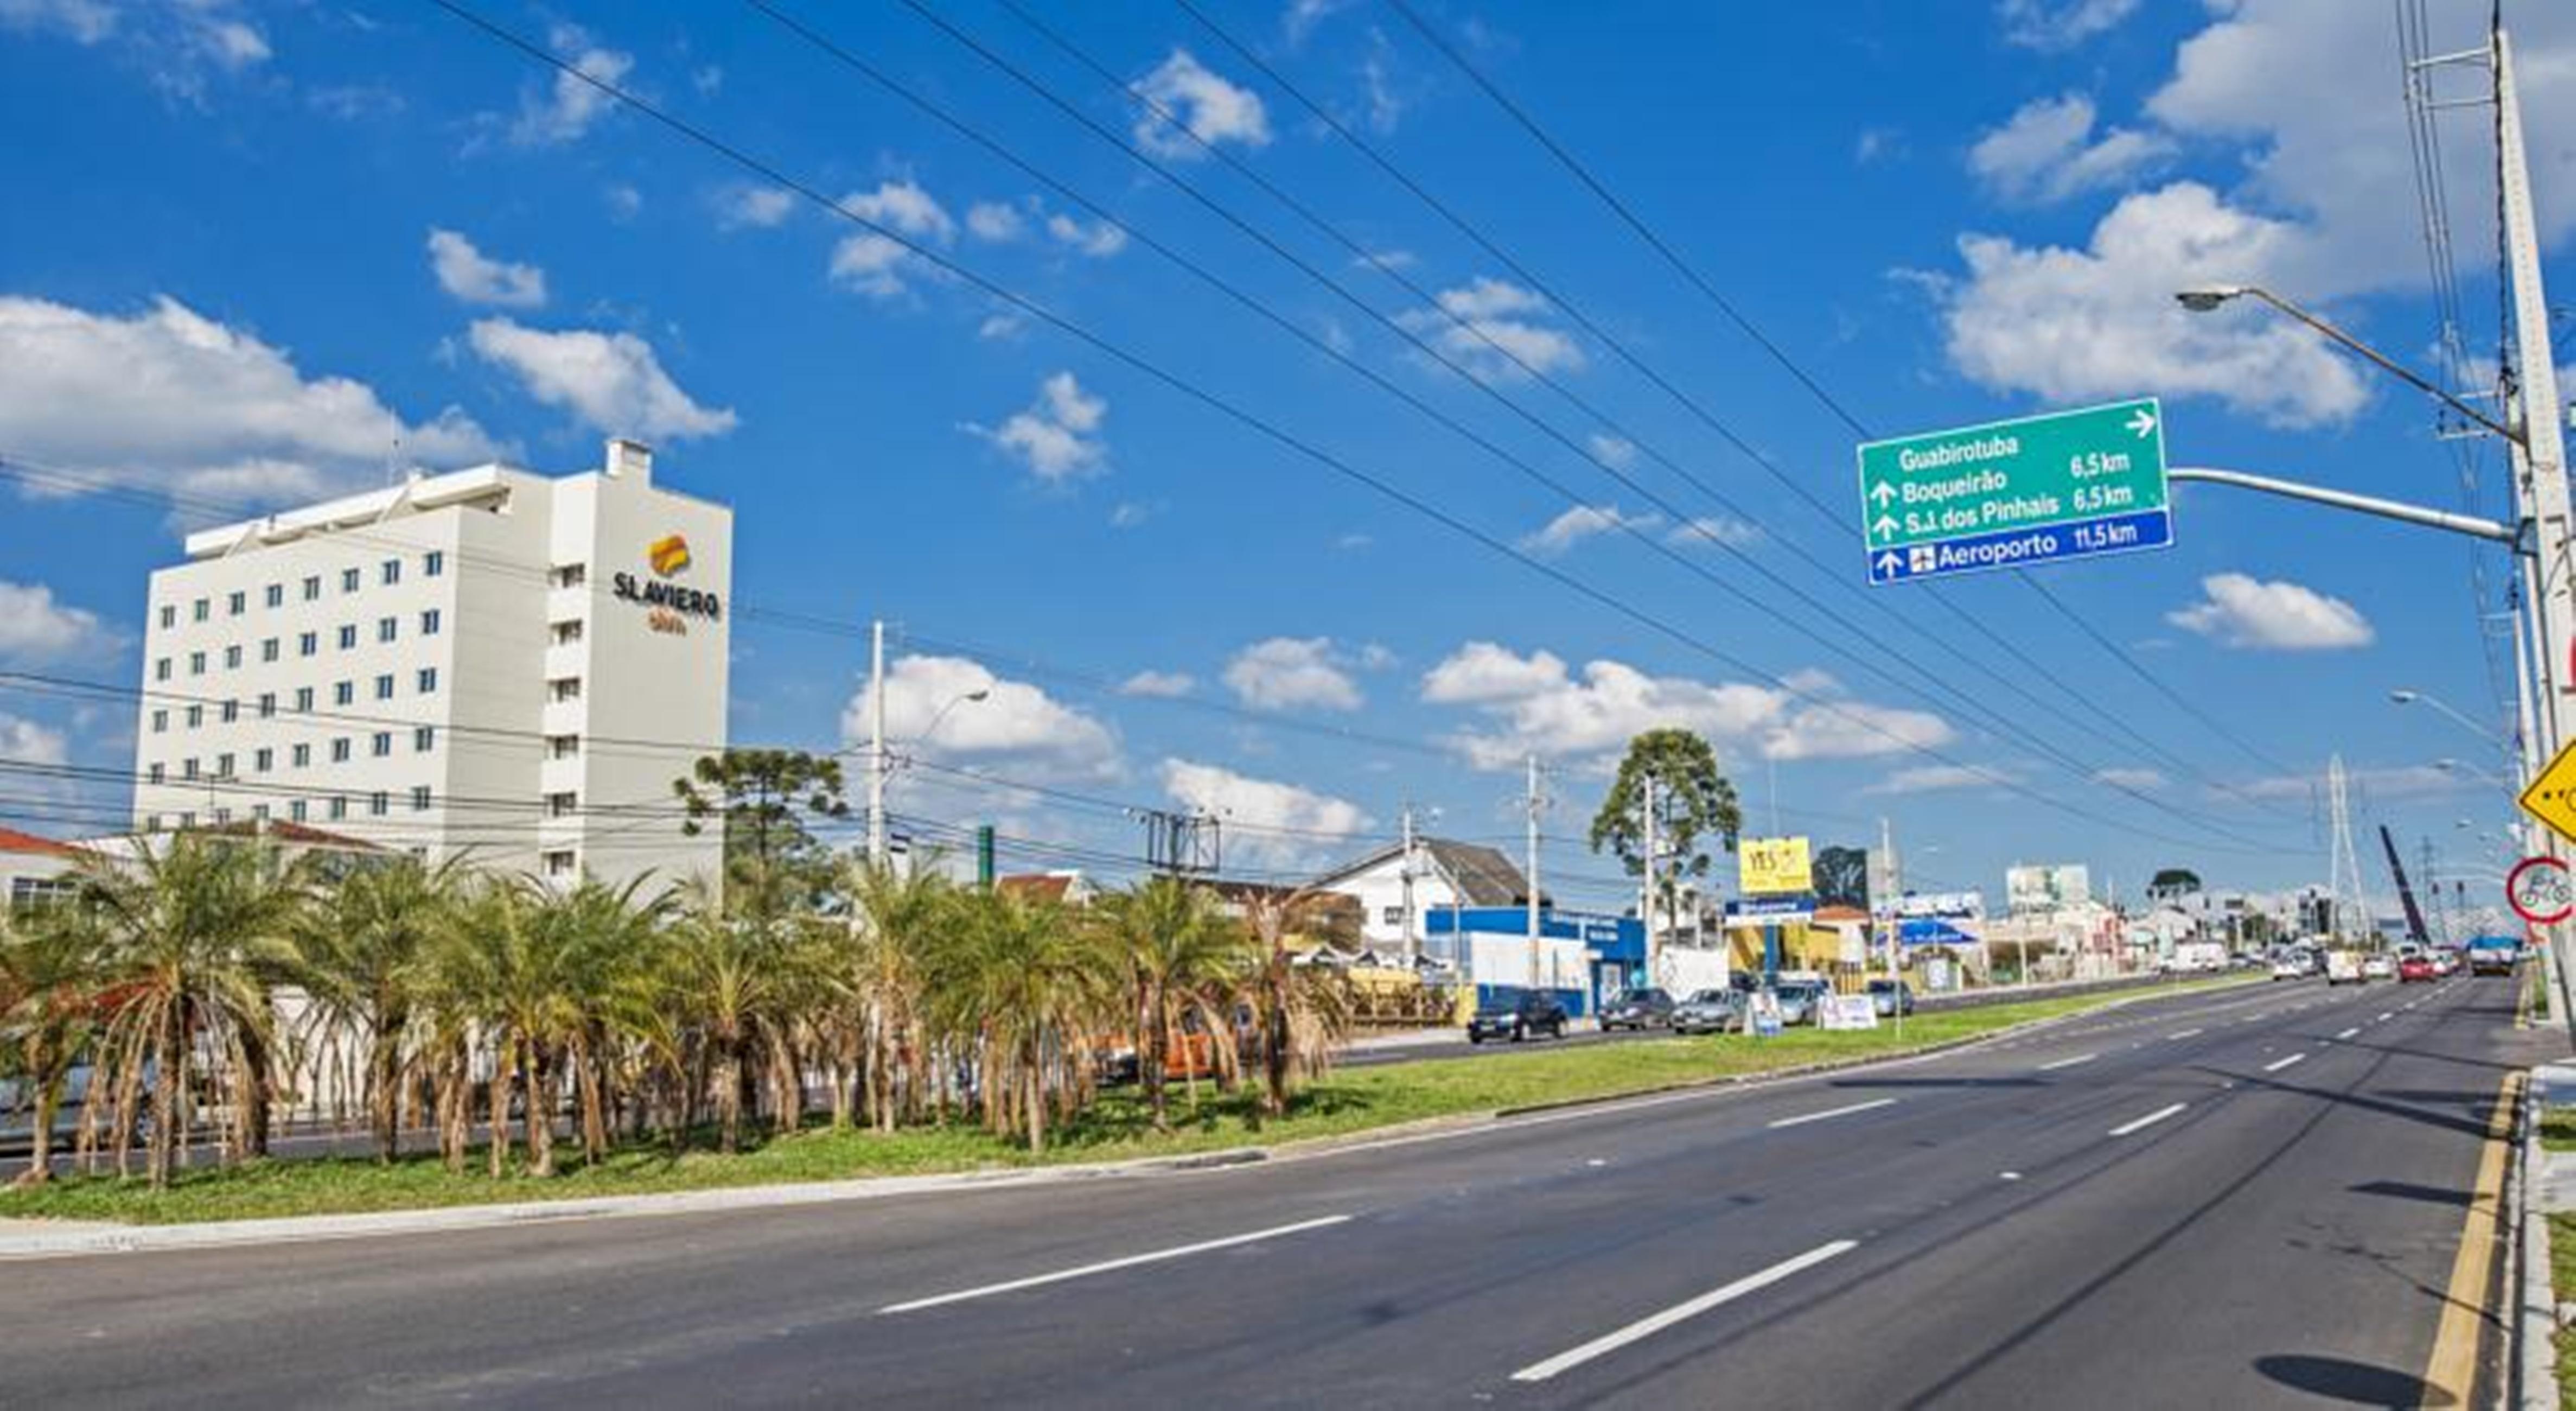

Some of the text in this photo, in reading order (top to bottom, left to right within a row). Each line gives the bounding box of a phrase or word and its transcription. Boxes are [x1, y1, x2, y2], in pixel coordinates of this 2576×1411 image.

[1900, 436, 2018, 471] Guabirotuba
[1902, 452, 2131, 504] Boqueirão 6,5 km
[1942, 507, 1978, 530] dos
[1982, 493, 2060, 523] Pinhais
[2103, 484, 2133, 506] km
[1939, 523, 2138, 568] Aeroporto 11,5 km
[613, 572, 719, 618] SLAVIERO
